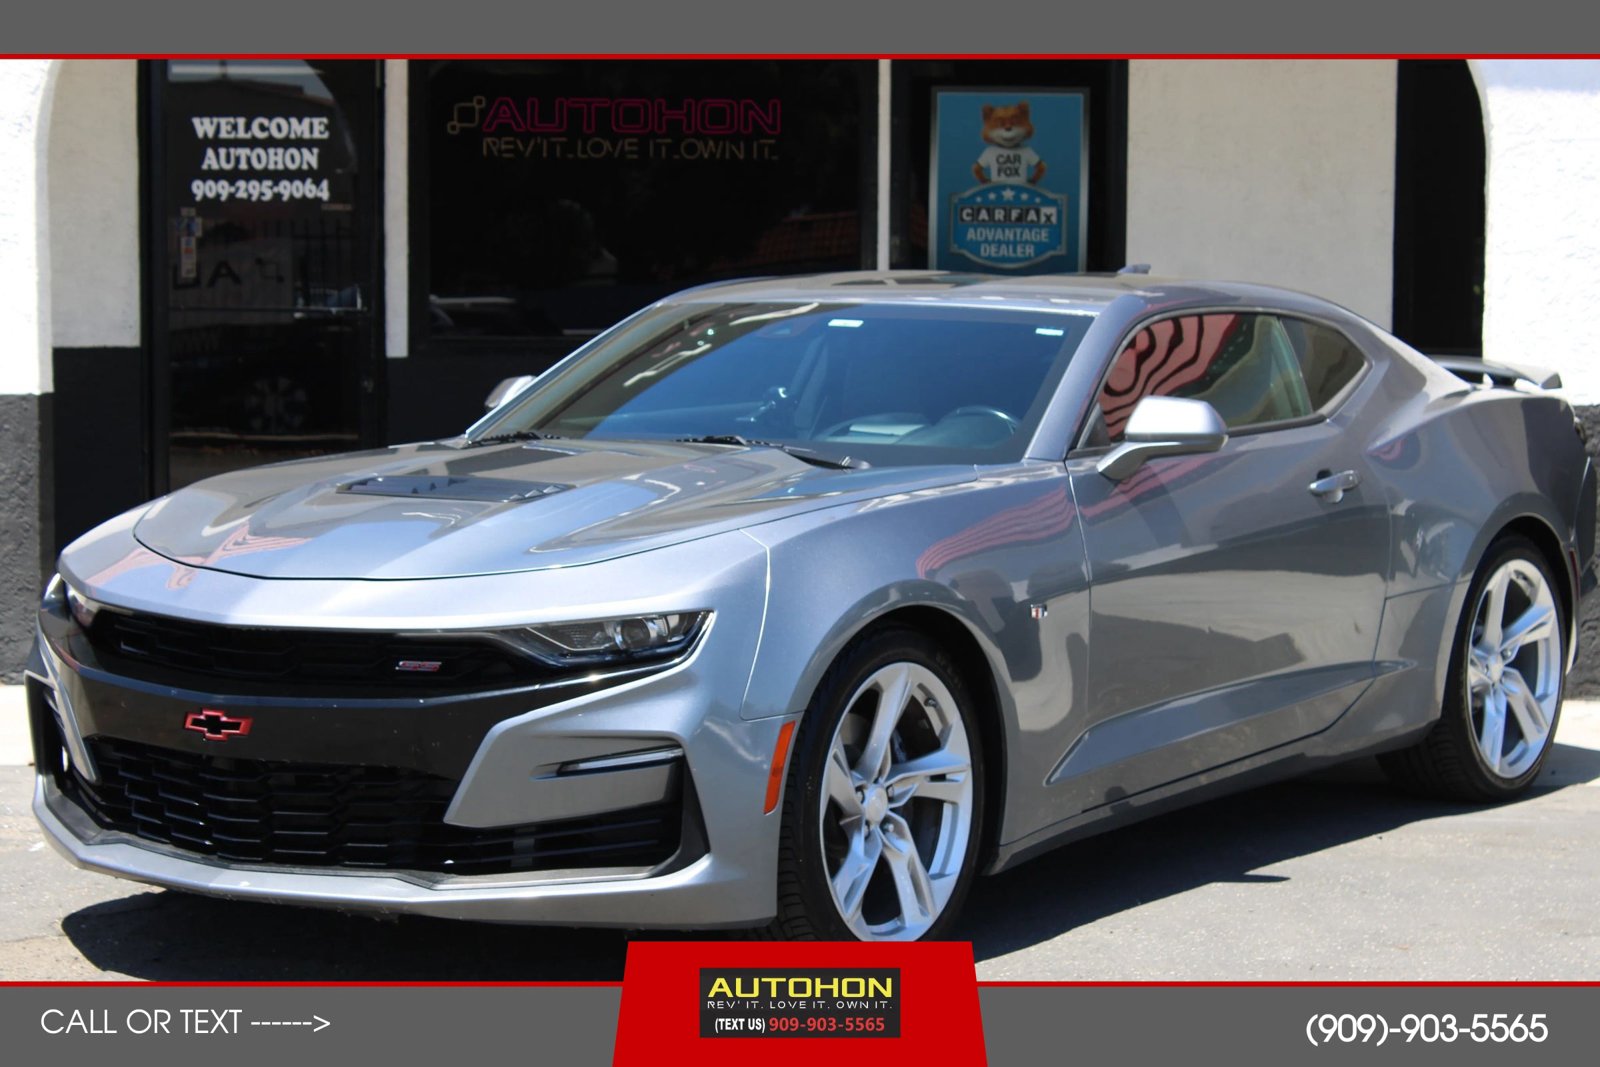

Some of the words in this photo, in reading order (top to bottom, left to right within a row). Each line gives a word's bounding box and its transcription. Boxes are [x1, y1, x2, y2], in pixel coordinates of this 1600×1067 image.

[482, 96, 783, 135] AUTOHON
[191, 116, 330, 140] WELCOME
[201, 146, 319, 171] AUTOHON
[996, 153, 1022, 166] CAR
[997, 166, 1021, 178] FOX
[191, 177, 330, 202] 909-295-9064
[960, 206, 1057, 224] CARFAX
[966, 227, 1050, 242] ADVANTAGE
[980, 242, 1035, 257] DEALER
